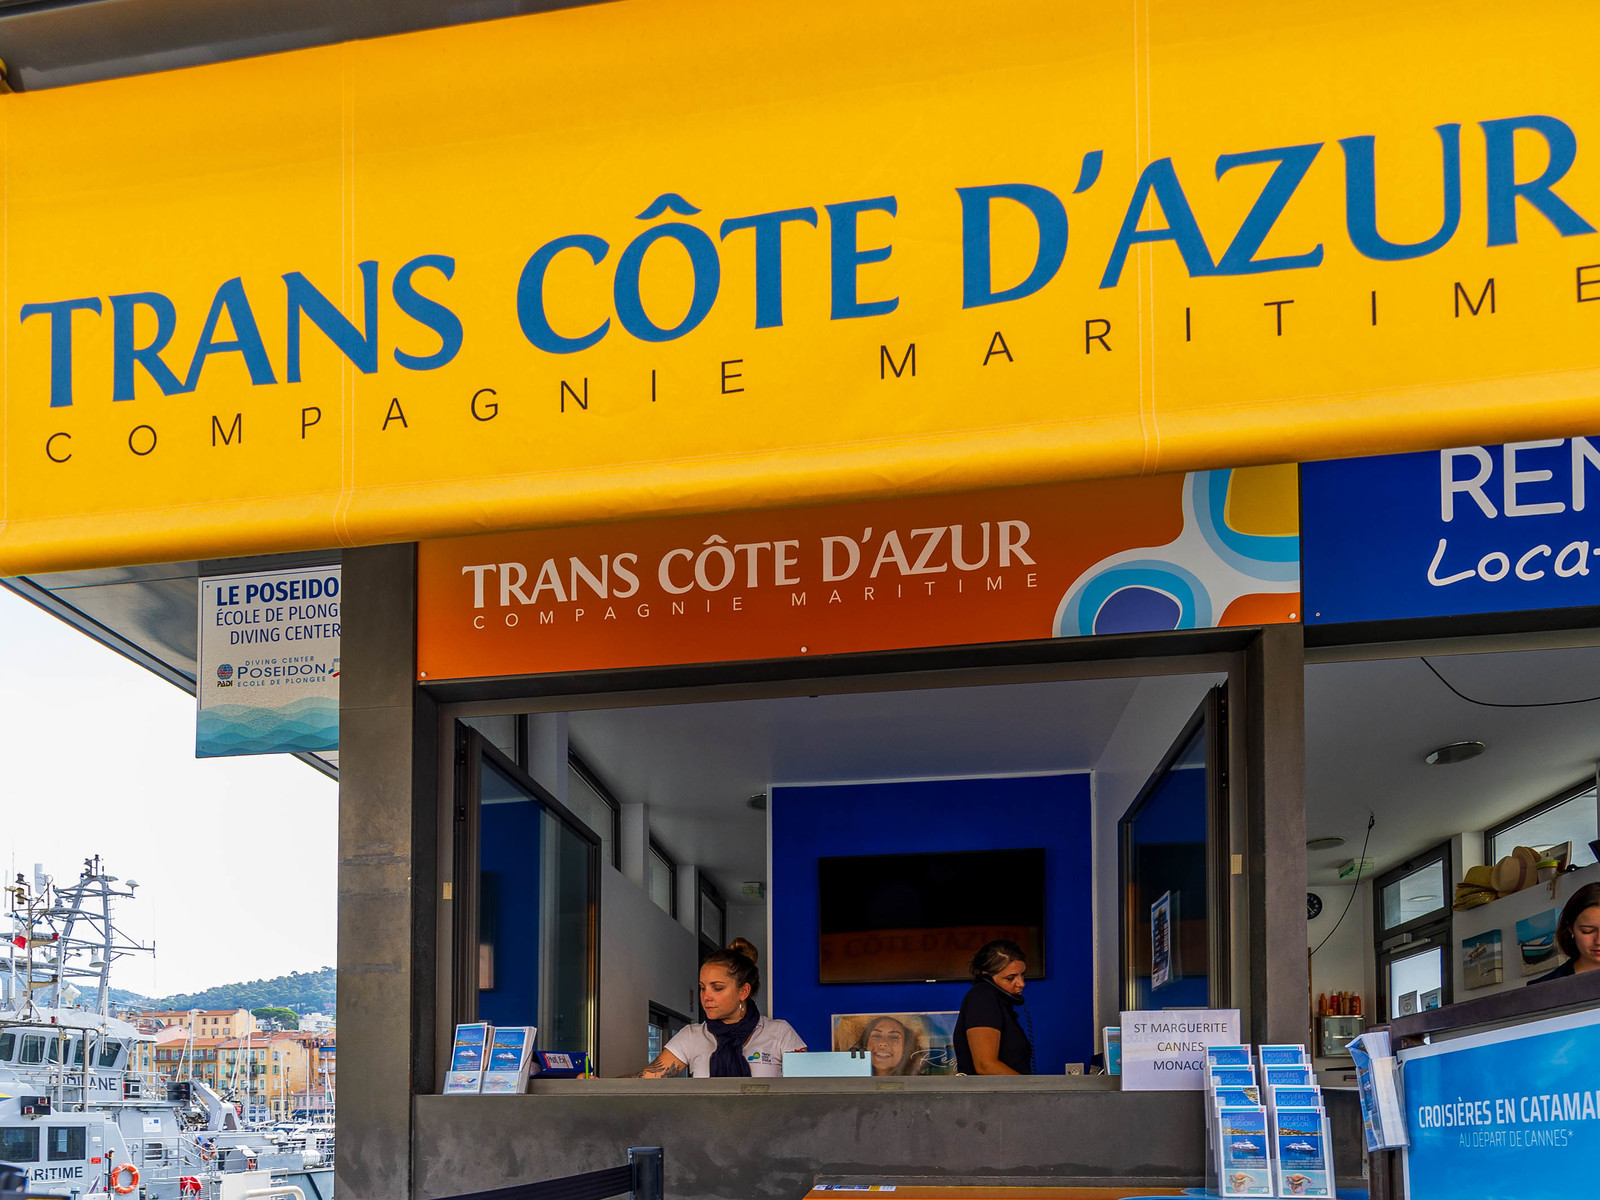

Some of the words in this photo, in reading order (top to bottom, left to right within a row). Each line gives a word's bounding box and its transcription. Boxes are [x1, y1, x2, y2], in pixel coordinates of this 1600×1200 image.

[20, 254, 464, 408] TRANS
[516, 193, 900, 354] CÔTE
[45, 359, 746, 464] COMPAGNIE
[880, 263, 1600, 380] MARITIME
[462, 552, 640, 608] TRANS
[658, 534, 800, 594] CÔTE
[1427, 538, 1600, 587] Loca
[217, 585, 239, 606] LE
[246, 576, 339, 604] POSEIDO
[473, 597, 743, 630] COMPAGNIE
[791, 573, 1038, 607] MARITIME
[216, 608, 260, 626] ÉCOLE
[265, 607, 284, 623] DE
[230, 627, 280, 645] DIVING
[285, 623, 340, 641] CENTER
[237, 663, 326, 680] POSEIDON
[245, 658, 277, 667] DIVING
[282, 655, 315, 664] CENTER
[216, 680, 233, 688] PADI
[237, 680, 265, 688] ECOLE
[285, 676, 326, 685] PLONGEE
[1134, 1023, 1147, 1033] ST
[1151, 1022, 1228, 1033] MARGUERITE
[1157, 1041, 1204, 1052] CANNES
[1419, 1097, 1492, 1128] CROISIÈRES
[1496, 1098, 1516, 1125] EN
[1520, 1090, 1600, 1123] CATAMA
[1459, 1133, 1471, 1148] AU
[1473, 1128, 1507, 1148] DÉPART
[1509, 1131, 1522, 1147] DE
